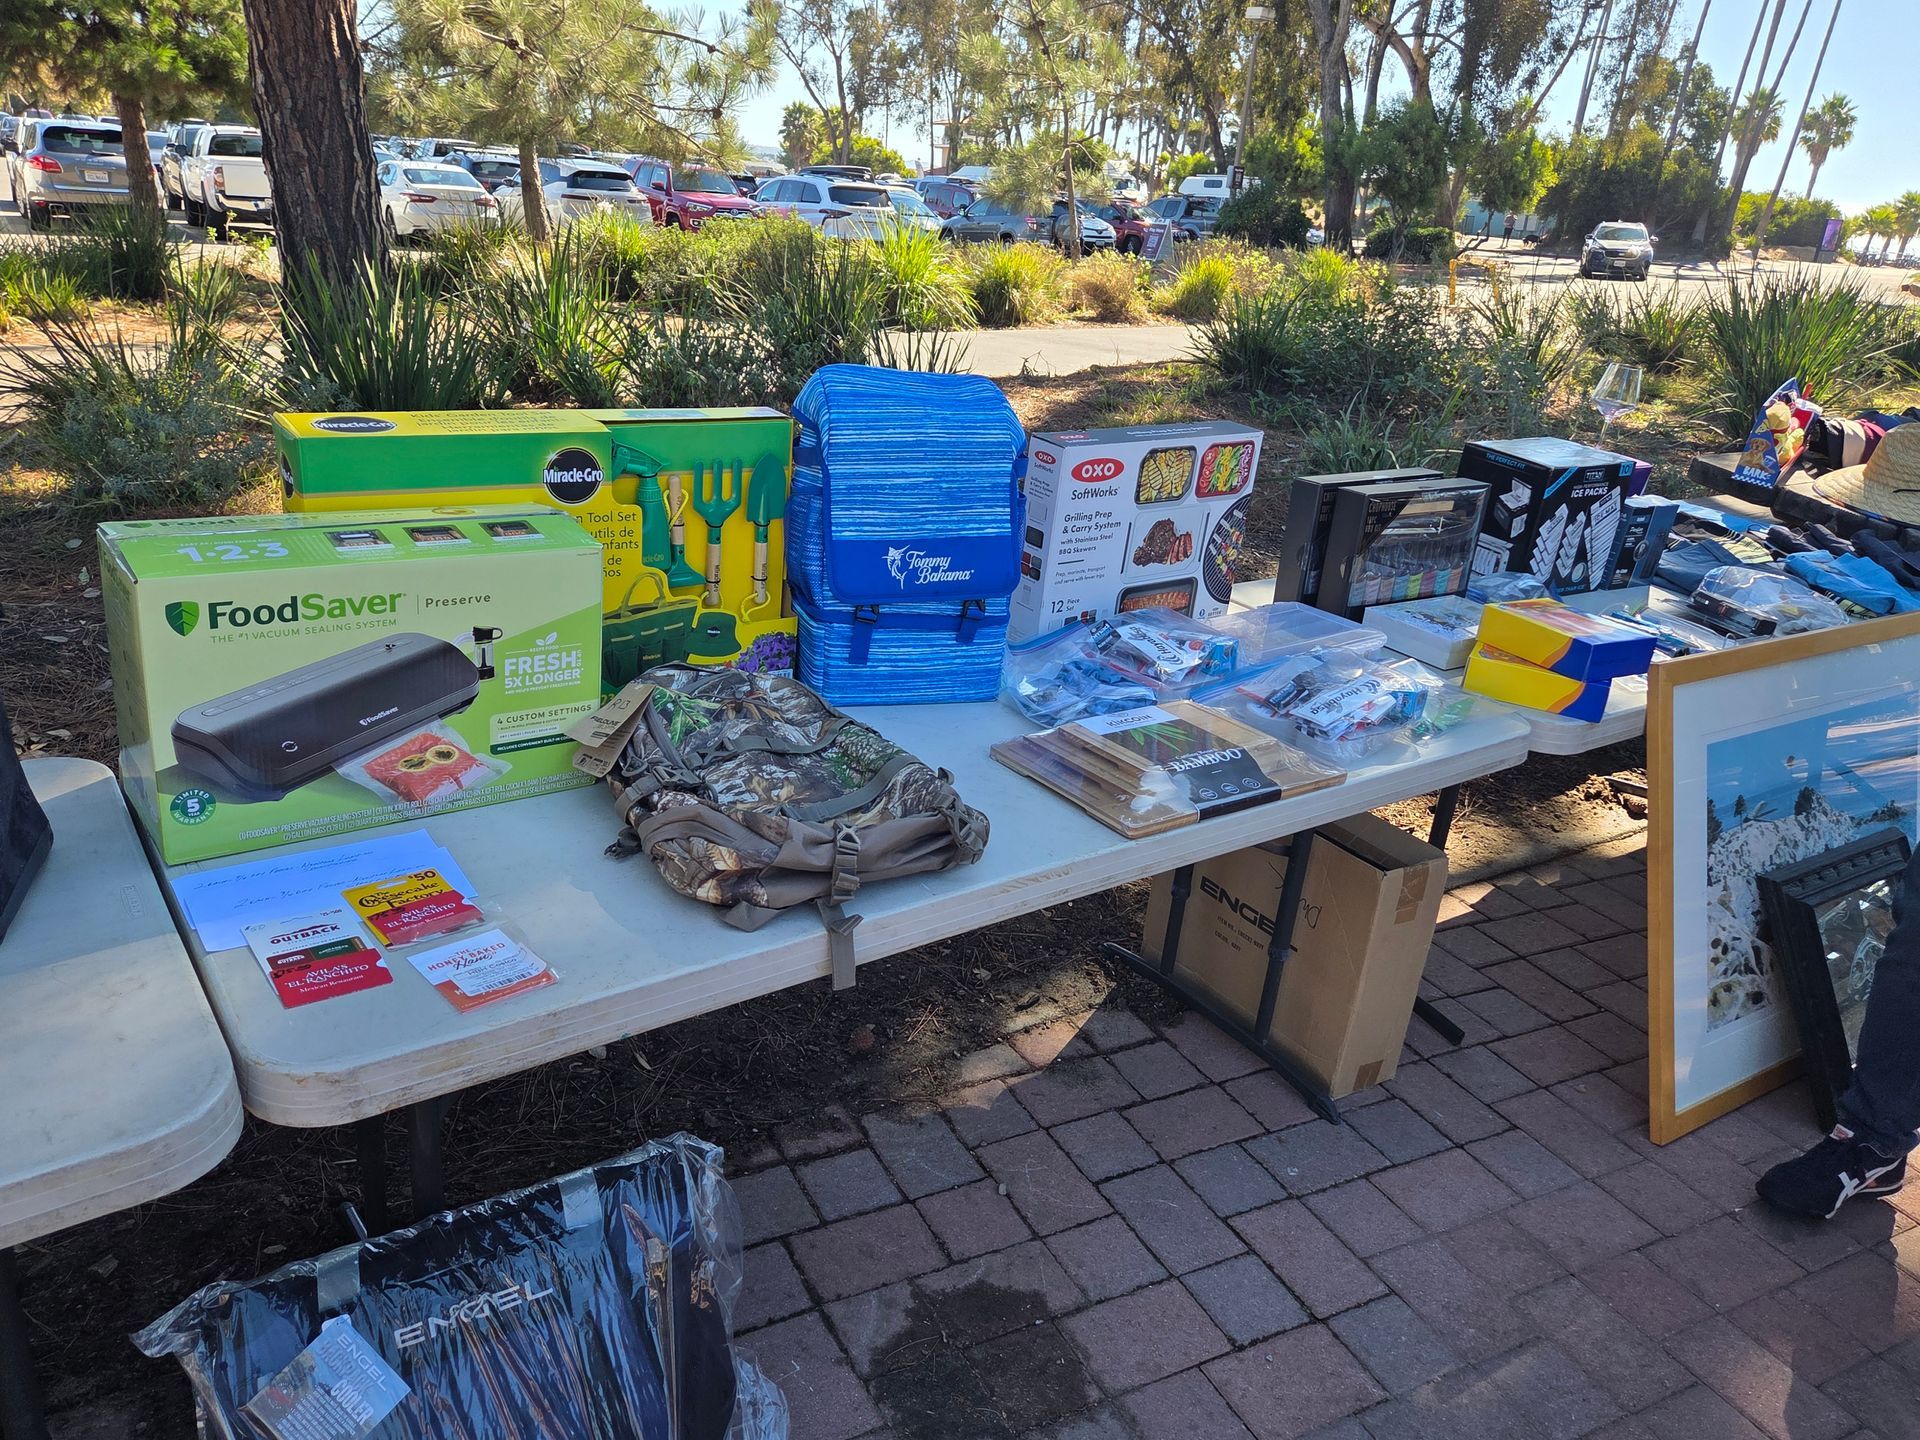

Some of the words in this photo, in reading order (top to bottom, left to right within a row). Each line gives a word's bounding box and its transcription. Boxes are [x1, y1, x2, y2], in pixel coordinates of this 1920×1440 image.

[1038, 452, 1052, 463] OXO
[1496, 454, 1517, 467] PERFECT
[543, 466, 604, 483] Miracle-Gro
[1081, 462, 1115, 478] OXO
[1620, 464, 1631, 475] 10
[1071, 486, 1119, 501] SoftWorks
[1571, 489, 1584, 498] ICE
[1584, 486, 1608, 496] PACKS
[586, 511, 613, 523] Tool
[617, 511, 637, 522] Set
[1064, 512, 1093, 523] Grilling
[1094, 510, 1113, 521] Prep
[619, 526, 634, 538] de
[1062, 527, 1069, 535] &
[1071, 524, 1092, 535] Carry
[1094, 521, 1121, 532] System
[602, 539, 639, 550] nfants
[1074, 534, 1099, 544] Stainless
[1099, 532, 1113, 541] Steel
[1059, 547, 1072, 556] BBQ
[1072, 545, 1097, 554] Skewers
[607, 554, 622, 566] de
[906, 550, 952, 570] Tommy
[915, 568, 972, 585] Bahama
[208, 592, 402, 630] FoodSaver
[425, 593, 491, 608] Preserve
[1051, 600, 1065, 614] 12
[210, 634, 235, 645] THE
[238, 632, 250, 642] #1
[251, 627, 301, 640] VACUUM
[305, 622, 351, 635] SEALING
[356, 618, 397, 630] SYSTEM
[505, 650, 577, 676] FRESH
[505, 676, 523, 689] 5X
[525, 669, 581, 688] LONGER
[497, 717, 503, 725] 4
[506, 711, 545, 724] CUSTOM
[548, 704, 592, 717] SETTINGS
[1172, 748, 1242, 772] BAMBOO
[175, 789, 210, 804] LIMITED
[187, 798, 200, 813] 5
[173, 805, 215, 826] WARRANTY
[409, 870, 437, 882] $50
[358, 881, 439, 908] Cheesecake
[383, 889, 445, 910] Factory
[401, 903, 437, 917] AVILA'S
[402, 902, 456, 922] RANCHITO
[1200, 876, 1298, 952] ENGE
[270, 924, 341, 945] OUTBACK
[427, 955, 466, 972] HONEY
[469, 942, 506, 959] BAKED
[456, 948, 470, 956] THE
[305, 964, 369, 984] RANCHITO
[306, 963, 348, 978] AVILA'S
[299, 982, 329, 993] Mexican
[329, 975, 364, 987] Restaurant
[337, 1334, 387, 1392] ENGEL
[331, 1379, 375, 1426] COOLER
